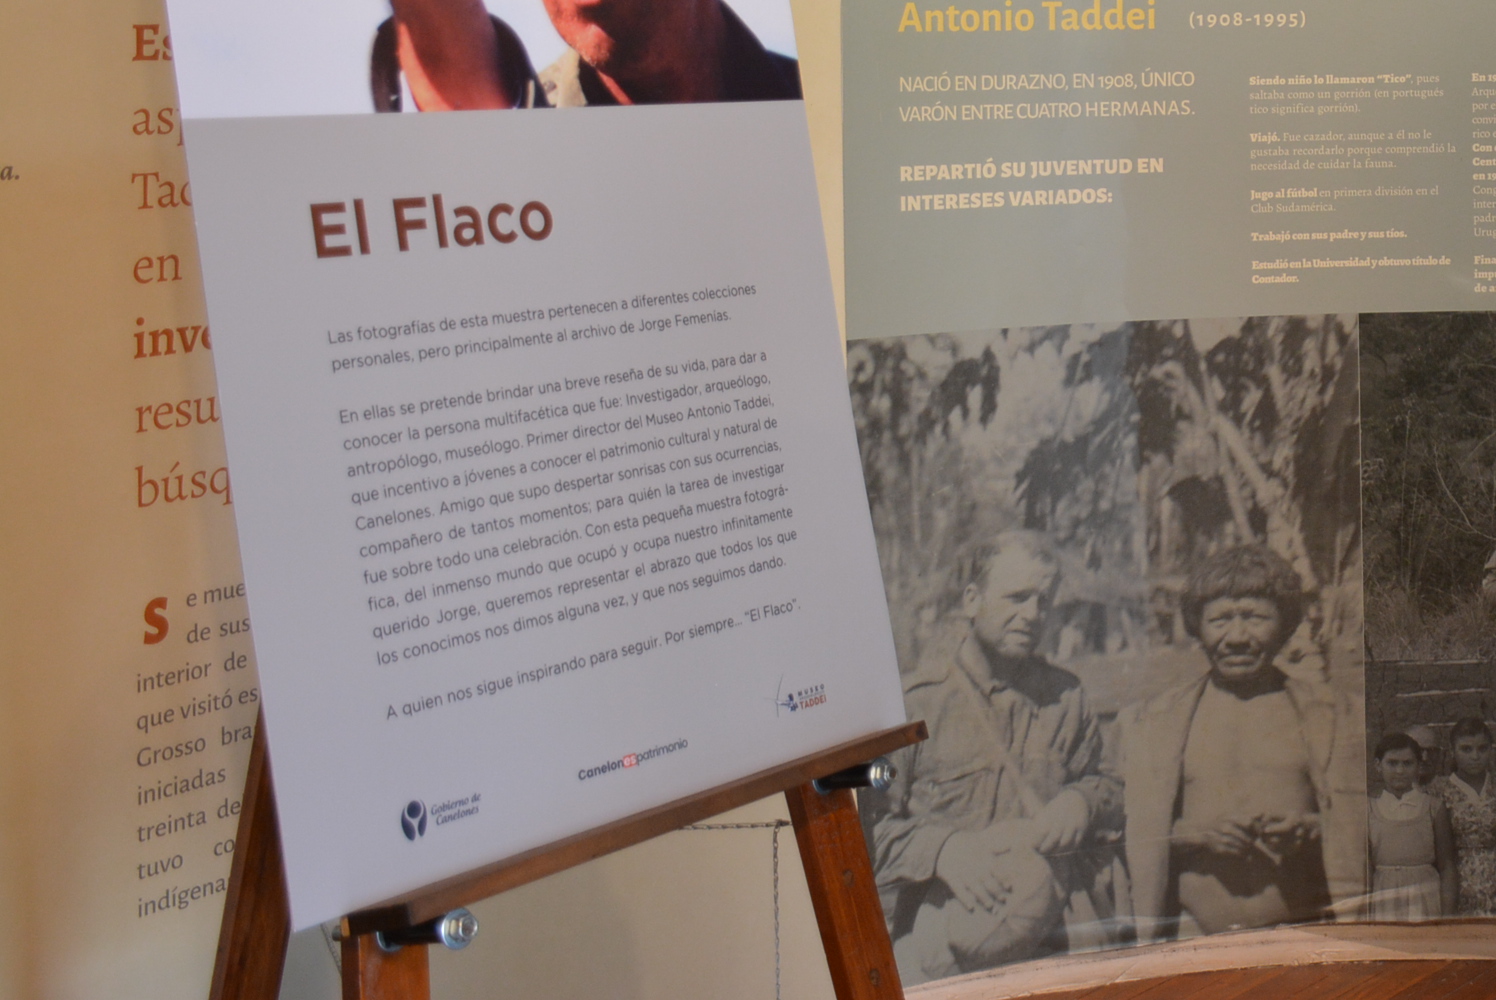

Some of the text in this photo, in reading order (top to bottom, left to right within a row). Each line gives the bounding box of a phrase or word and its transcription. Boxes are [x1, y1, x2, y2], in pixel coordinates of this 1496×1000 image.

[898, 0, 1035, 32] Antonio
[1189, 10, 1306, 29] (1908-1995)
[899, 67, 1195, 92] NACIÓ EN DURAZNO, EN 1908, ÚNICO
[1249, 75, 1287, 86] Siendo
[1287, 74, 1313, 85] niño
[1313, 74, 1325, 85] lo
[1325, 74, 1375, 85] llamaron
[1416, 75, 1440, 86] pues
[1249, 89, 1285, 100] saltaba
[1287, 91, 1315, 99] como
[1317, 91, 1331, 99] un
[1333, 88, 1371, 101] gorrión
[1392, 87, 1444, 100] portugués
[1471, 72, 1487, 82] En
[132, 106, 184, 146] as
[898, 99, 1195, 122] VARÓN ENTRE CUATRO HERMANAS.
[1249, 106, 1269, 114] tico
[1271, 102, 1315, 116] significa
[1283, 132, 1301, 142] Fue
[1347, 132, 1385, 143] aunque
[1387, 132, 1394, 140] a
[1396, 129, 1405, 140] él
[1408, 132, 1421, 140] no
[1423, 128, 1432, 139] le
[900, 157, 1164, 182] REPARTIÓ SU JUVENTUD EN
[900, 187, 1113, 212] INTERESES VARIADOS:
[310, 194, 553, 259] El Flaco
[134, 254, 182, 284] en
[327, 284, 757, 345] Las fotografías de esta muestra pertenecen a diferentes colecciones
[331, 309, 732, 374] personales, pero principalmente al archivo de Jorge Femenías.
[338, 351, 767, 425] En ellas se pretende brindar una breve reseña de su vida, para dar a
[136, 396, 220, 434] resu
[342, 374, 771, 451] conocer la persona multifacética que fue: Investigador, arqueólogo,
[346, 394, 775, 478] antropólogo, museólogo. Primer director del Museo Antonio Taddei,
[187, 617, 251, 644] de sus
[137, 651, 247, 693] interior de
[386, 598, 801, 721] A quien nos sigue inspirando para seguir. Por siempre... “El Flaco”.
[137, 687, 258, 734] que visitó es
[799, 694, 827, 710] TADDEI
[137, 725, 252, 768] Grosso bra
[137, 767, 226, 806] iniciadas
[430, 792, 482, 816] Gobierno de
[137, 799, 242, 842] treinta de
[435, 805, 479, 826] Canelones
[137, 839, 236, 880] tuvo co
[137, 877, 227, 918] indígena
